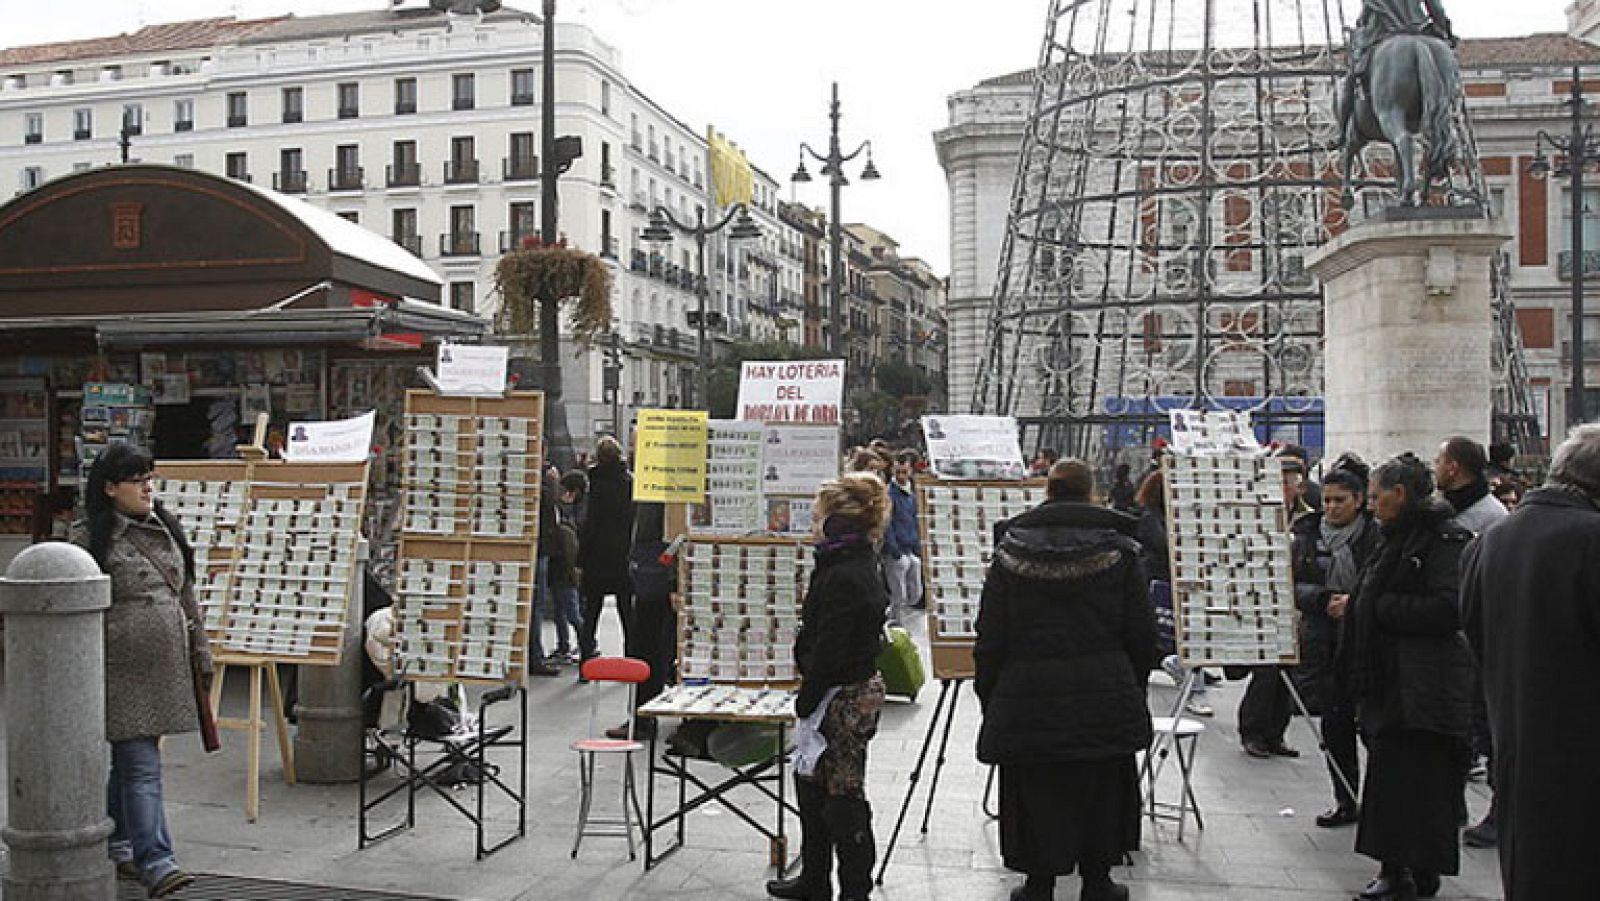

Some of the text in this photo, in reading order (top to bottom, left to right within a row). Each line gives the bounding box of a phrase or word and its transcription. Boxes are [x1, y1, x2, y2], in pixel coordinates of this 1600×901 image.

[746, 363, 840, 380] HAY LOTERIA
[776, 385, 804, 401] DEL
